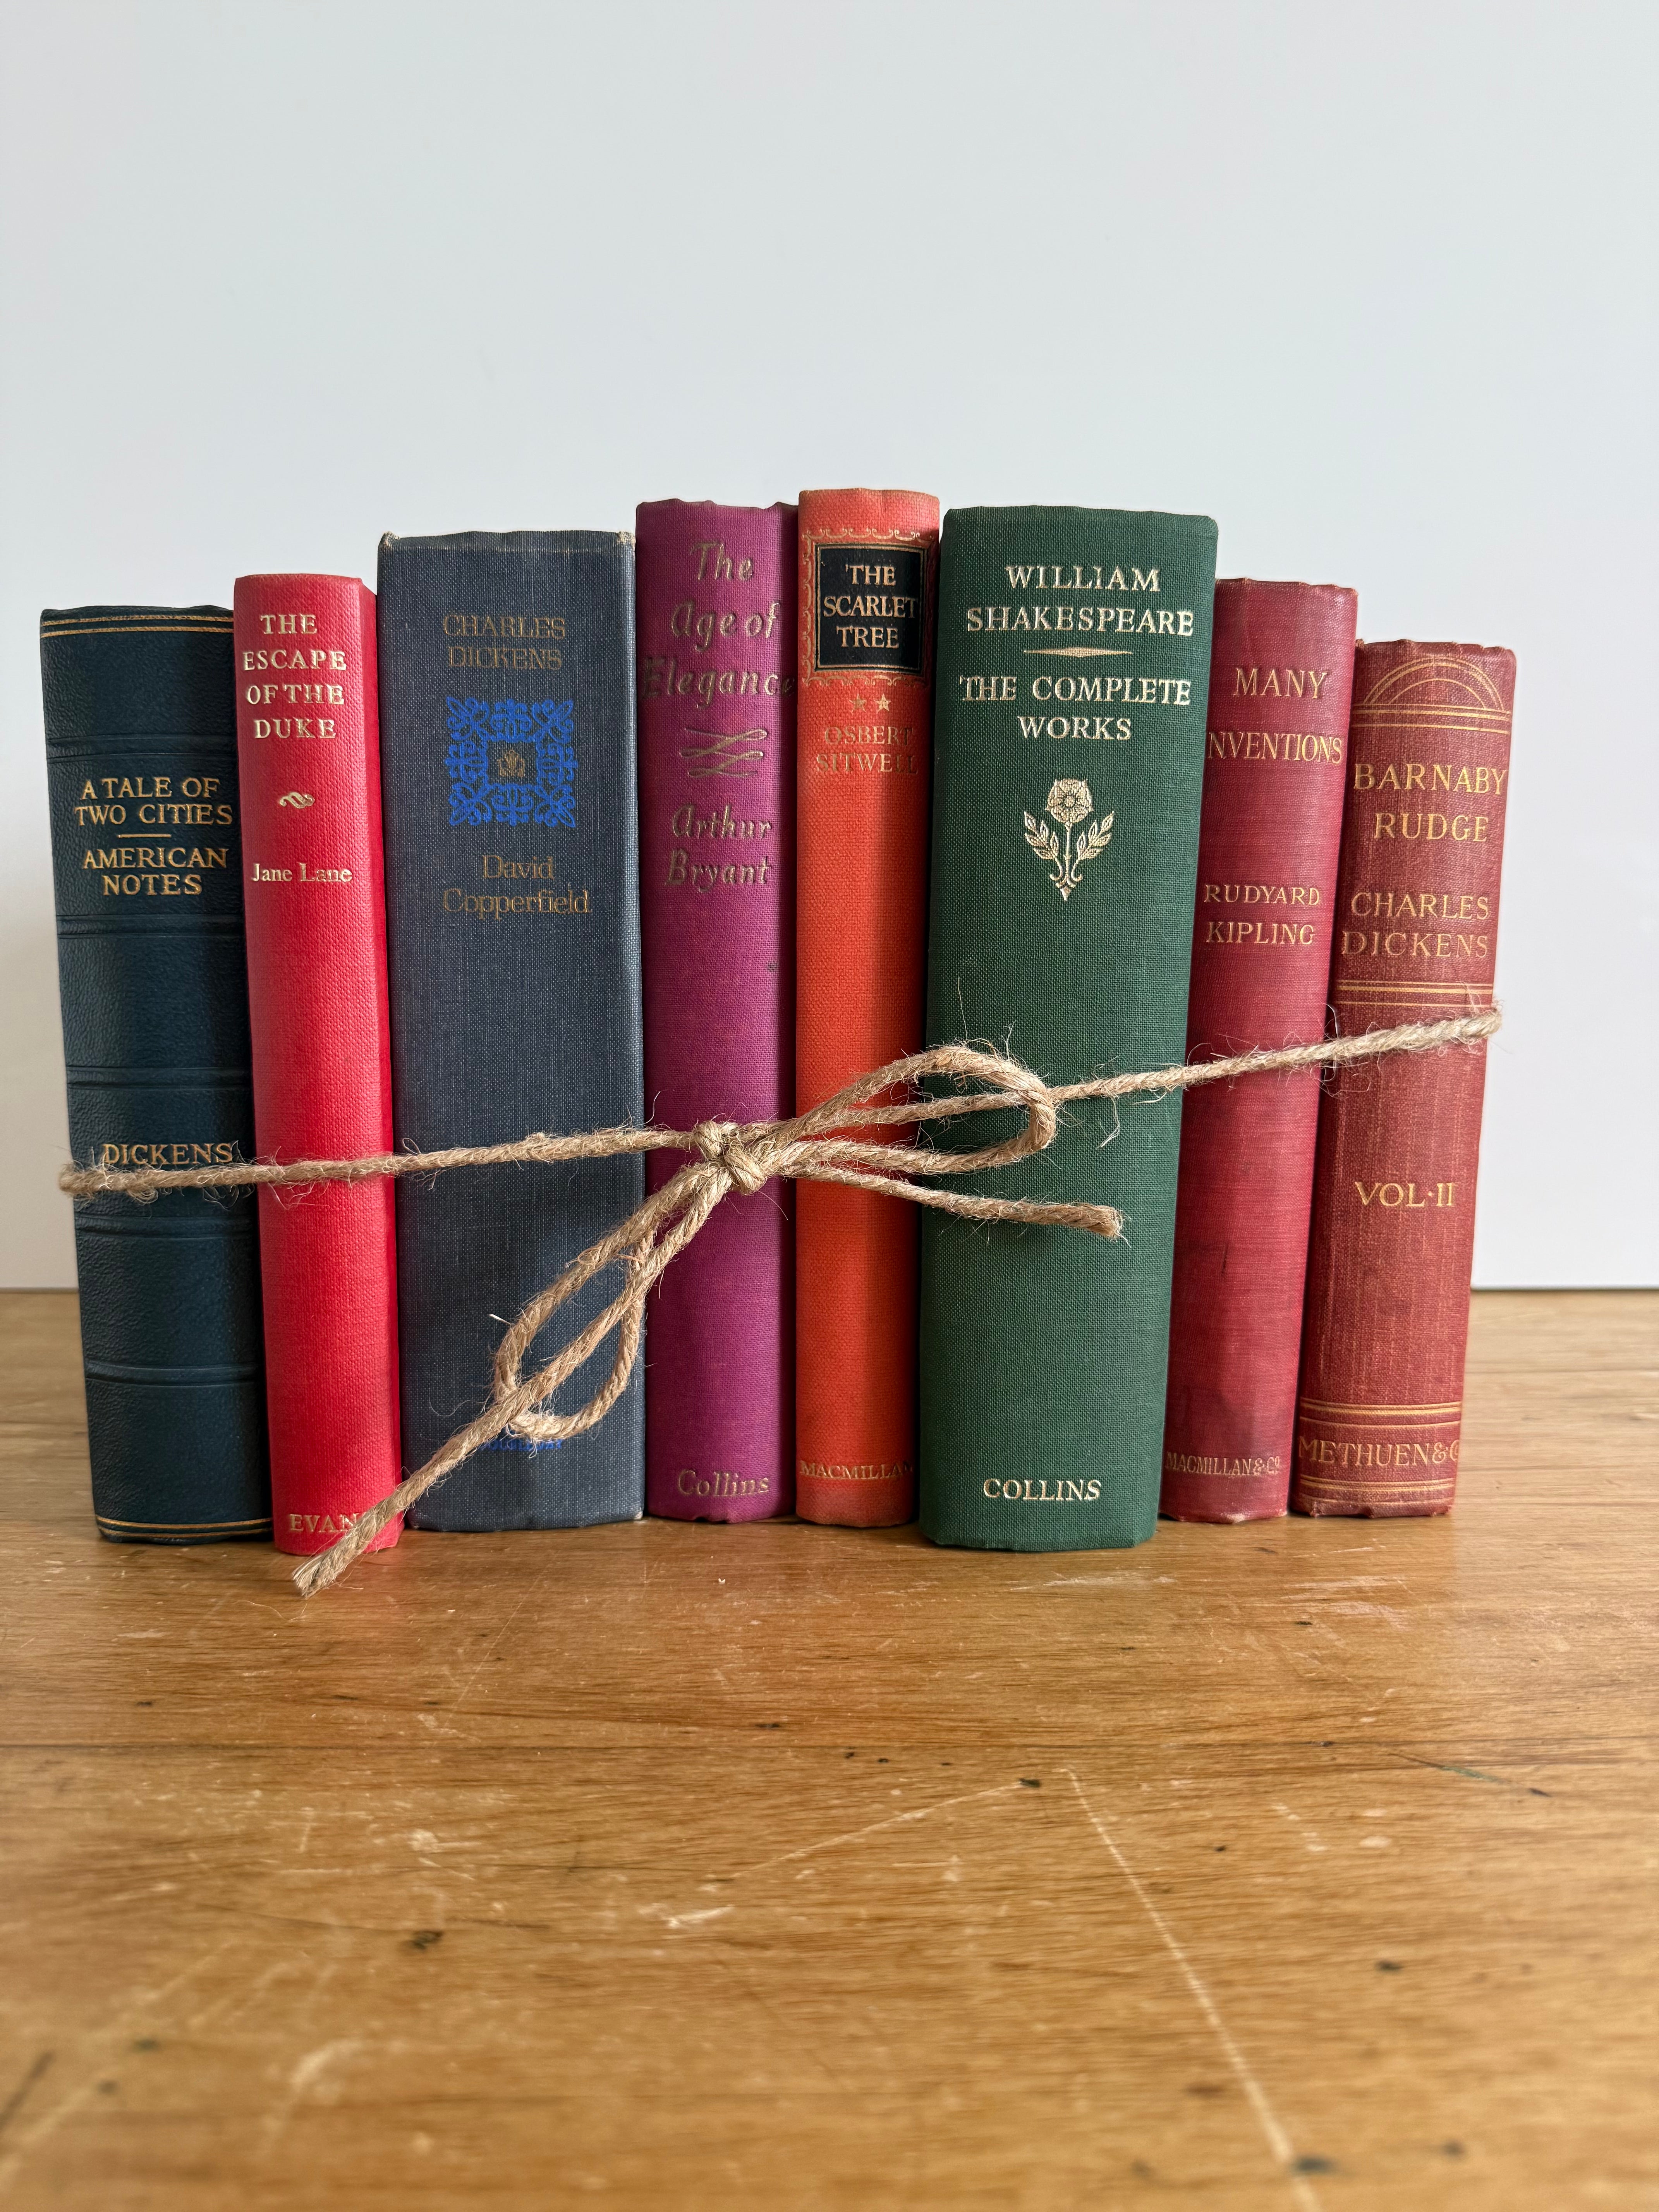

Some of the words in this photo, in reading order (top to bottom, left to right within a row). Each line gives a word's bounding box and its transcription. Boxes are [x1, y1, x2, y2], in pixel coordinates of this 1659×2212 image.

[690, 541, 755, 582] The
[845, 564, 896, 587] THE
[1006, 565, 1161, 592] WILLIAM
[823, 594, 916, 620] SCARLET
[260, 613, 318, 635] THE
[443, 614, 565, 640] CHARLES
[671, 600, 737, 652] Age
[745, 601, 781, 640] of
[967, 606, 1194, 637] SHAKESPEARE
[836, 626, 899, 649] TREE
[242, 649, 347, 672] ESCAPE
[448, 646, 562, 671] DICKENS
[246, 685, 278, 706] OF
[282, 684, 345, 706] THE
[959, 675, 1017, 702] THE
[1032, 676, 1192, 706] COMPLETE
[1233, 667, 1328, 699] MANY
[254, 718, 337, 740] DUKE
[824, 726, 913, 746] OSBERT
[1017, 716, 1133, 740] WORKS
[1207, 731, 1344, 765] NVENTIONS
[816, 753, 920, 775] SITWELL
[81, 778, 98, 801] A
[100, 776, 173, 799] TALE
[182, 778, 222, 800] OF
[1352, 762, 1508, 797] BARNABY
[74, 805, 127, 827] TWO
[138, 803, 234, 826] CITIES
[672, 802, 773, 840] Arthur
[1373, 812, 1490, 843] RUDGE
[82, 847, 230, 871] AMERICAN
[482, 853, 555, 881] David
[665, 847, 771, 893] Bryant
[252, 864, 294, 883] Jane
[300, 862, 354, 883] Lane
[102, 874, 204, 897] NOTES
[1204, 884, 1321, 906] RUDYARD
[443, 888, 592, 920] Copperfield
[1350, 890, 1491, 920] CHARLES
[1204, 921, 1315, 946] KIPLING
[1340, 932, 1489, 959] DICKENS
[102, 1142, 233, 1166] DICKENS
[678, 1469, 771, 1496] Collins
[983, 1478, 1102, 1501] COLLINS
[289, 1513, 361, 1532] EVAN
